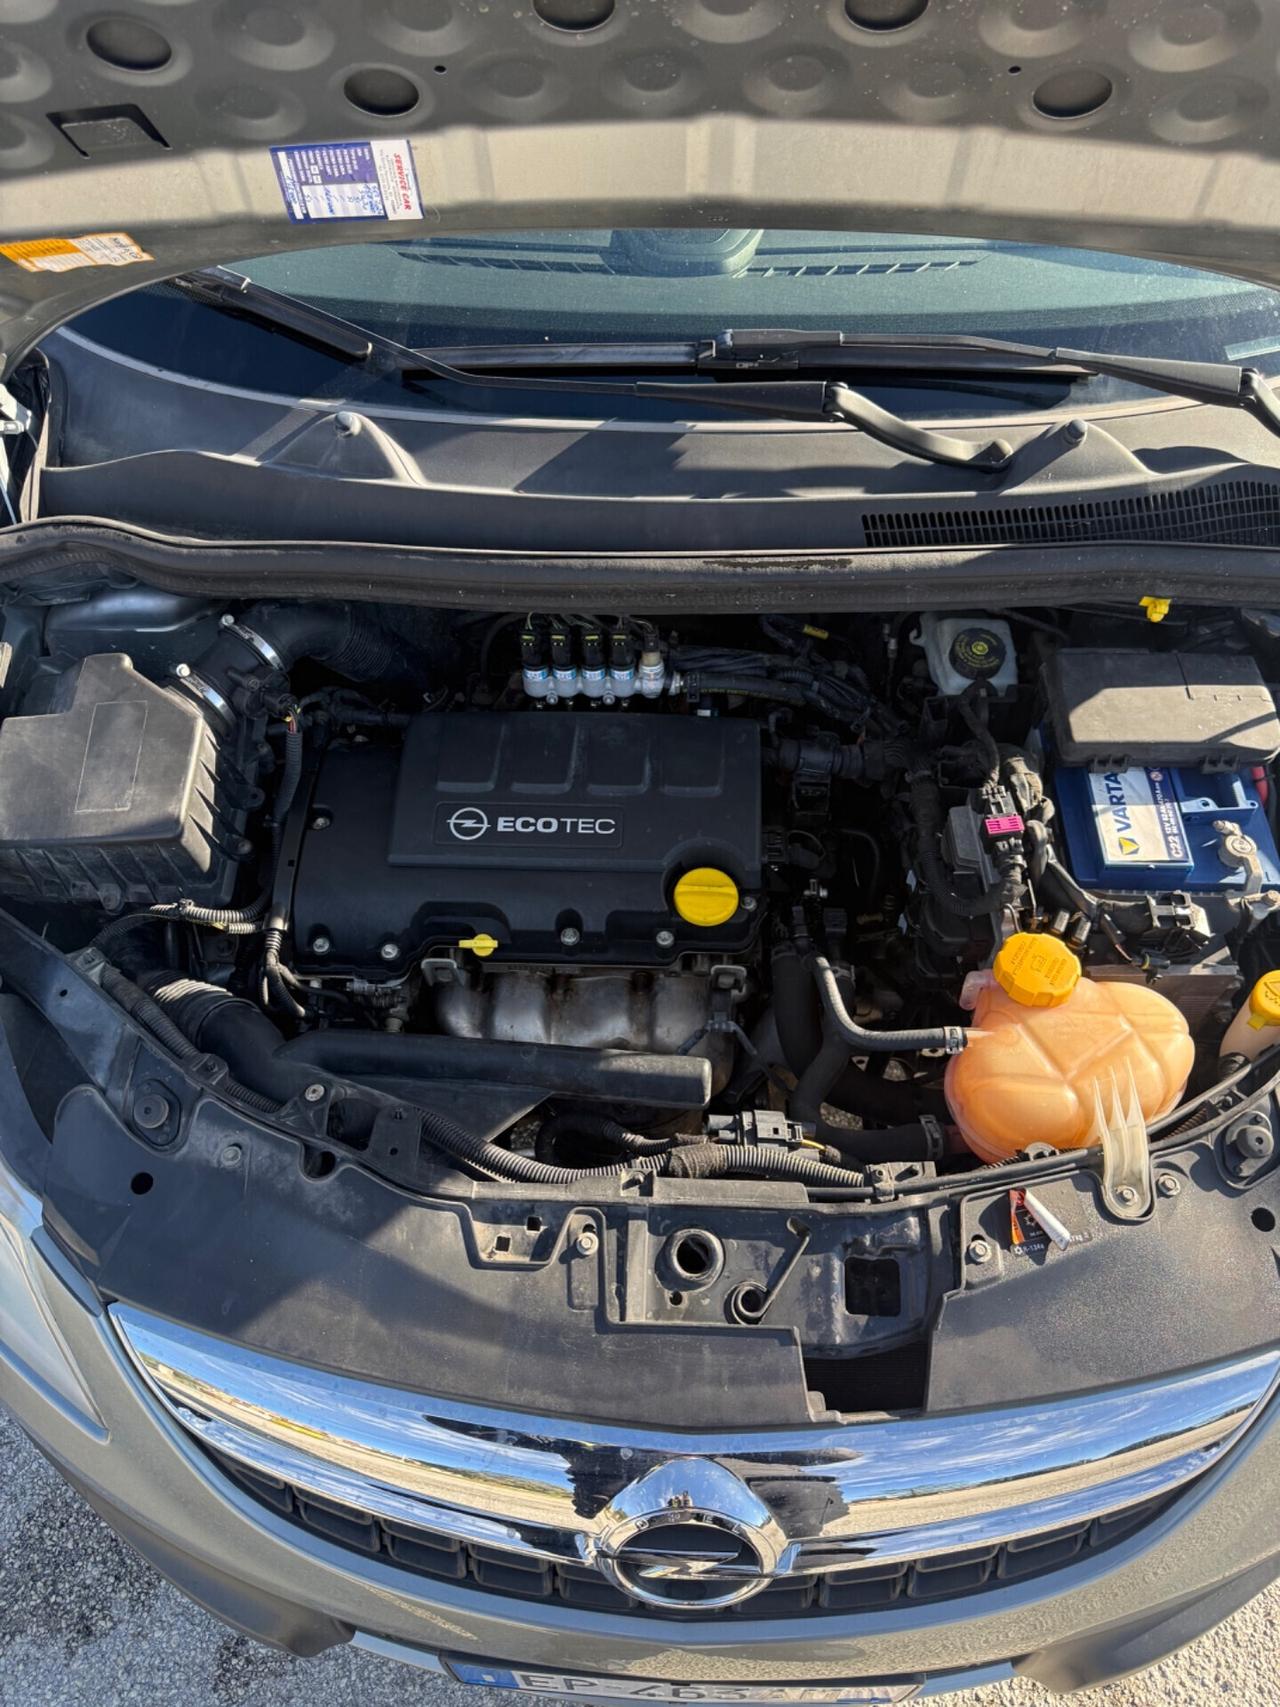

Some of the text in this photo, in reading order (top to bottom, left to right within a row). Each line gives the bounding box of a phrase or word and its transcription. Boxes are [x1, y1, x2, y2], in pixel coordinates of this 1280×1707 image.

[393, 153, 408, 190] SERVICE
[403, 194, 413, 210] CAR
[497, 816, 615, 834] ECOTEC
[1104, 772, 1132, 833] VARTA
